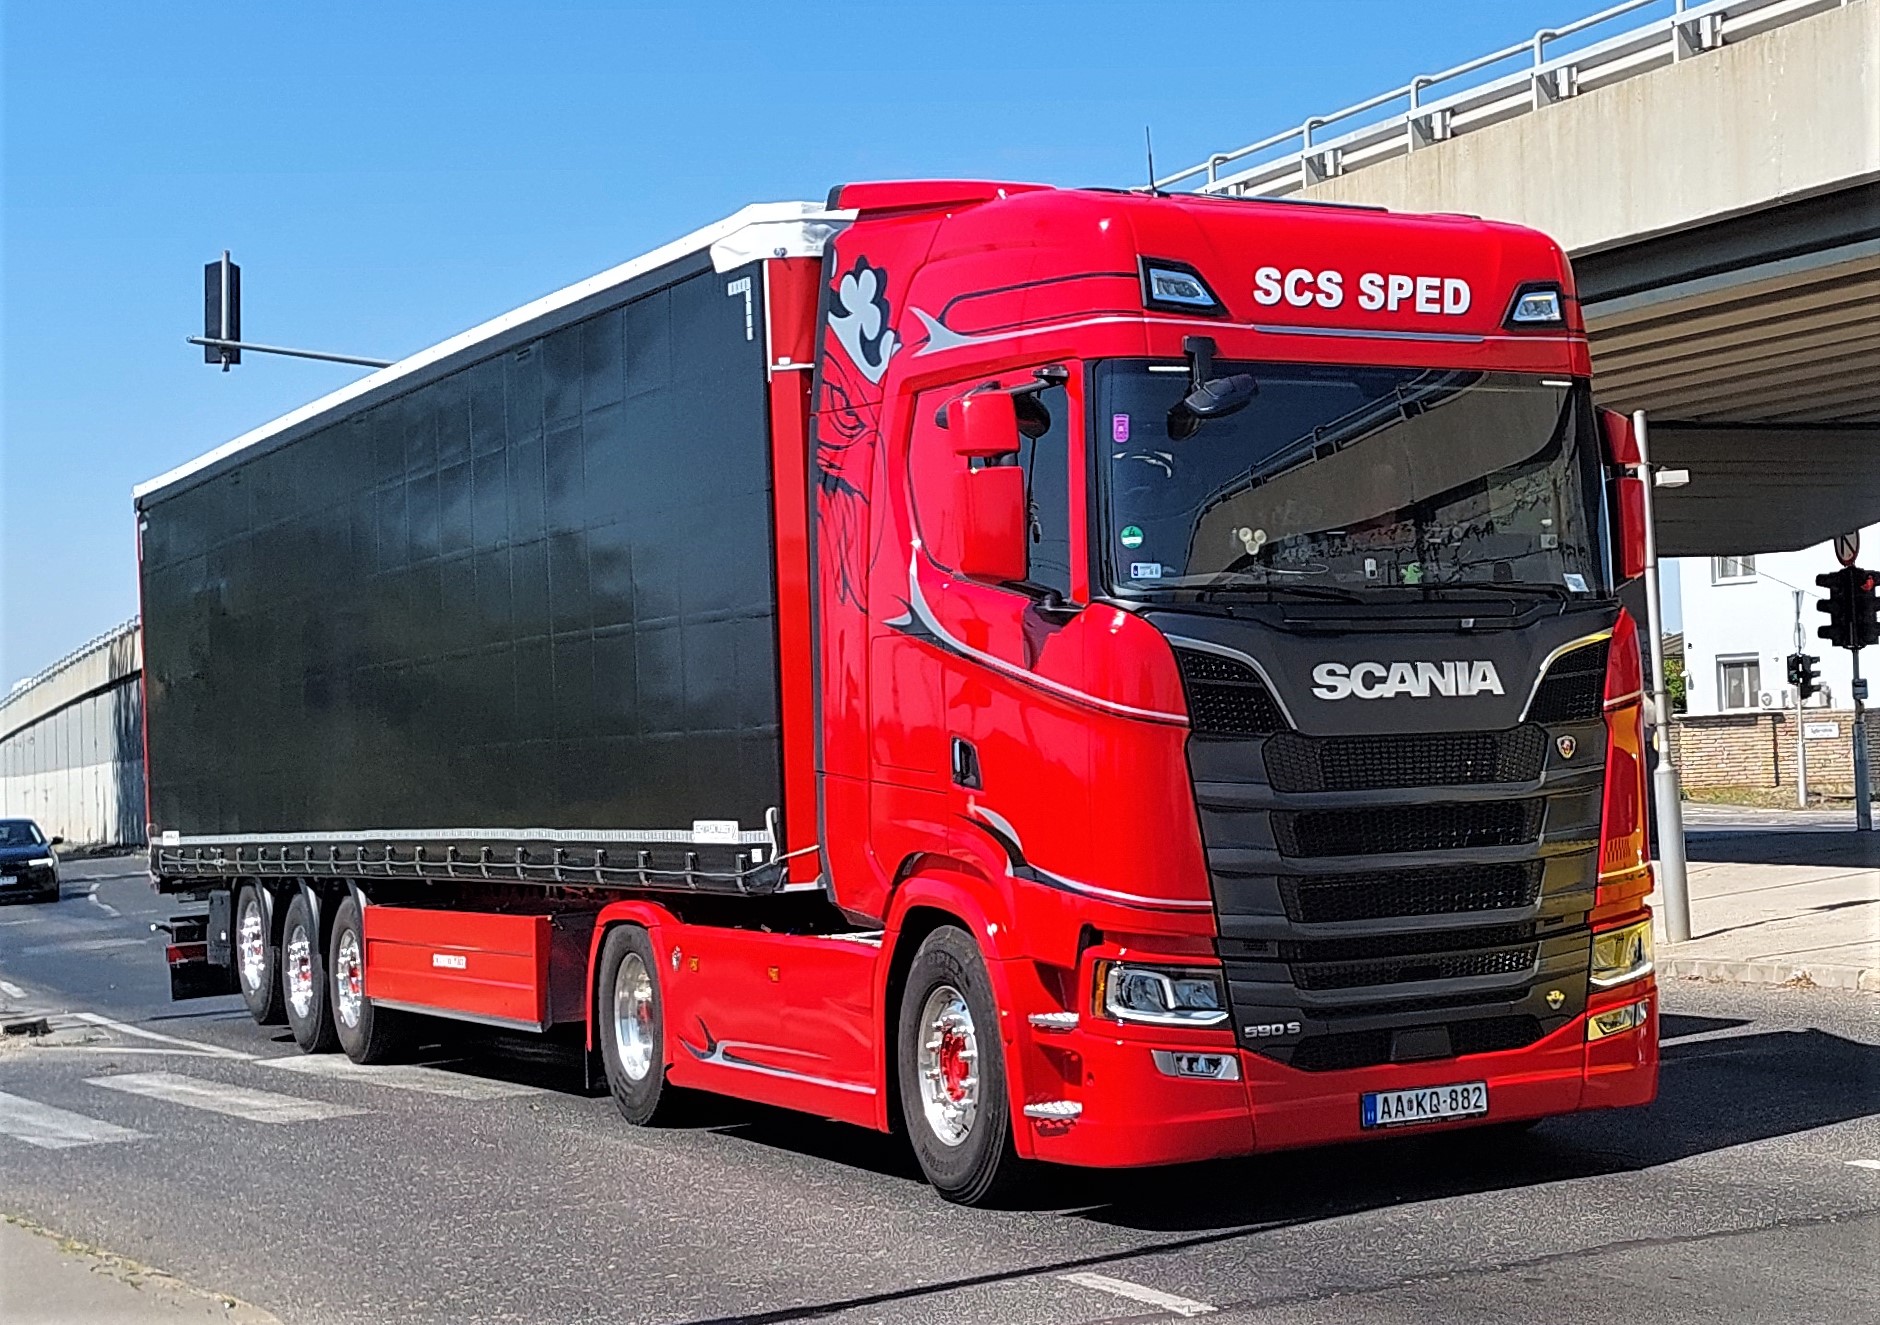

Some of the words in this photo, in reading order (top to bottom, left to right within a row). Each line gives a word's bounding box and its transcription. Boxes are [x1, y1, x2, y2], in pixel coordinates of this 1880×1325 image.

[1253, 266, 1343, 309] SCS
[1357, 272, 1471, 315] SPED
[1311, 660, 1505, 700] SCANIA
[1244, 1023, 1285, 1038] 590
[1286, 1021, 1301, 1034] S
